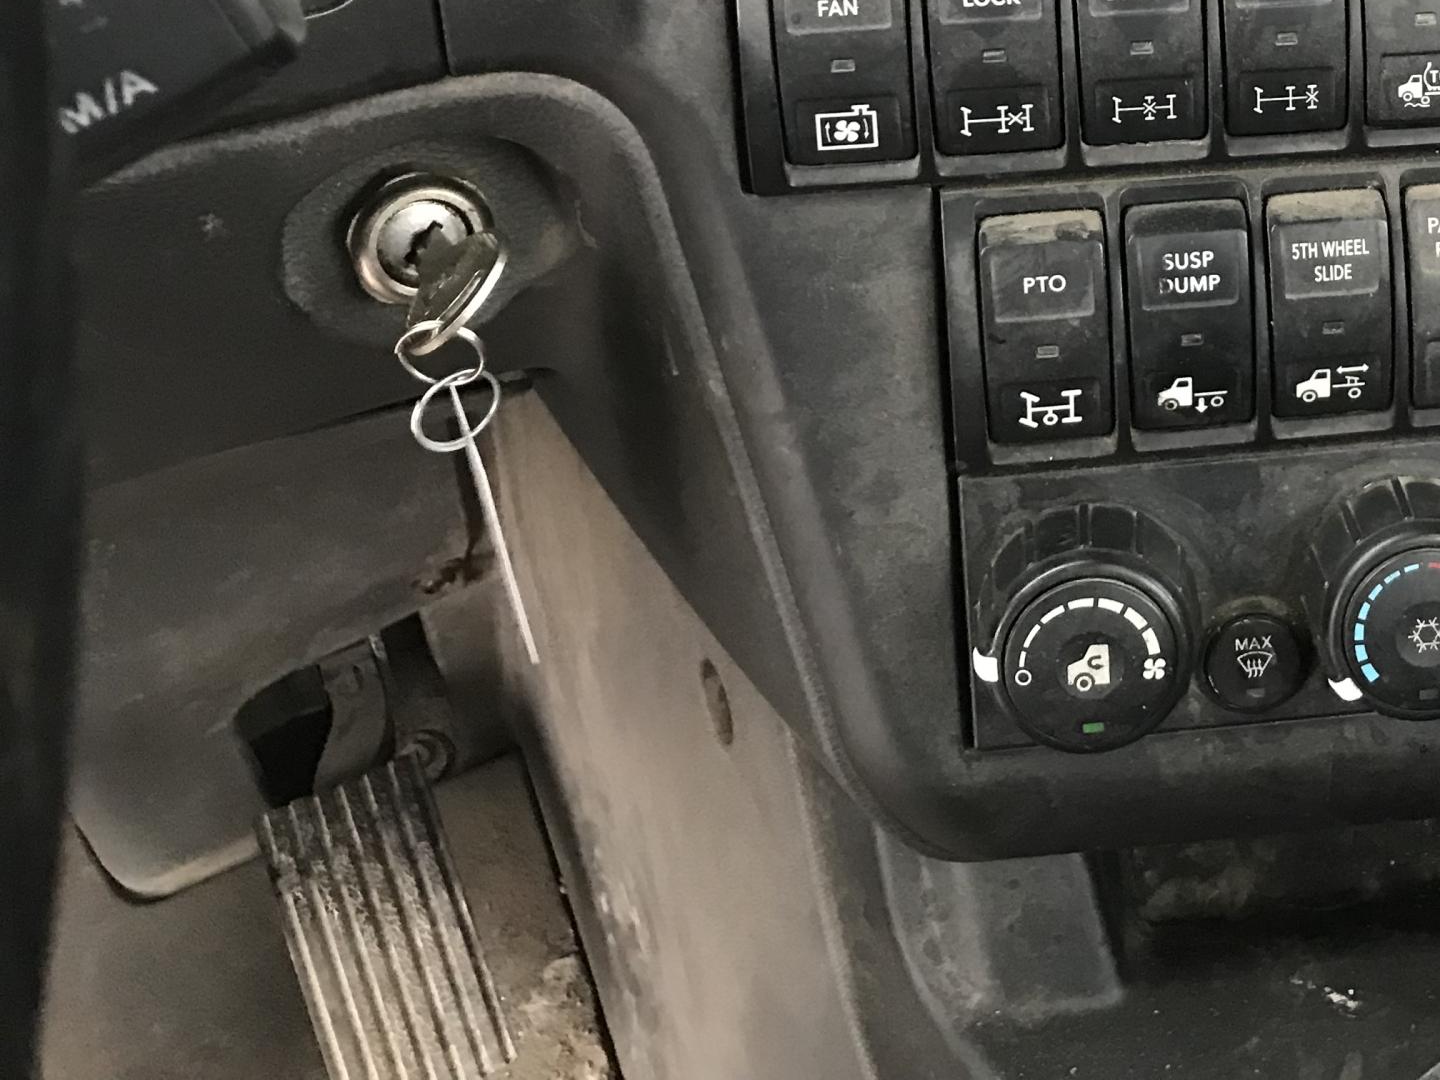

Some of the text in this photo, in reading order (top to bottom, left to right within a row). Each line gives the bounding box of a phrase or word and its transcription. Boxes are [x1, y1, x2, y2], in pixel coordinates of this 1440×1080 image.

[1291, 238, 1370, 261] 5TH WHEEL
[1162, 250, 1214, 271] SUSP
[1314, 264, 1353, 283] SLIDE
[1023, 274, 1067, 294] PTO
[1160, 274, 1221, 294] DUMP
[1234, 635, 1273, 651] MAX
